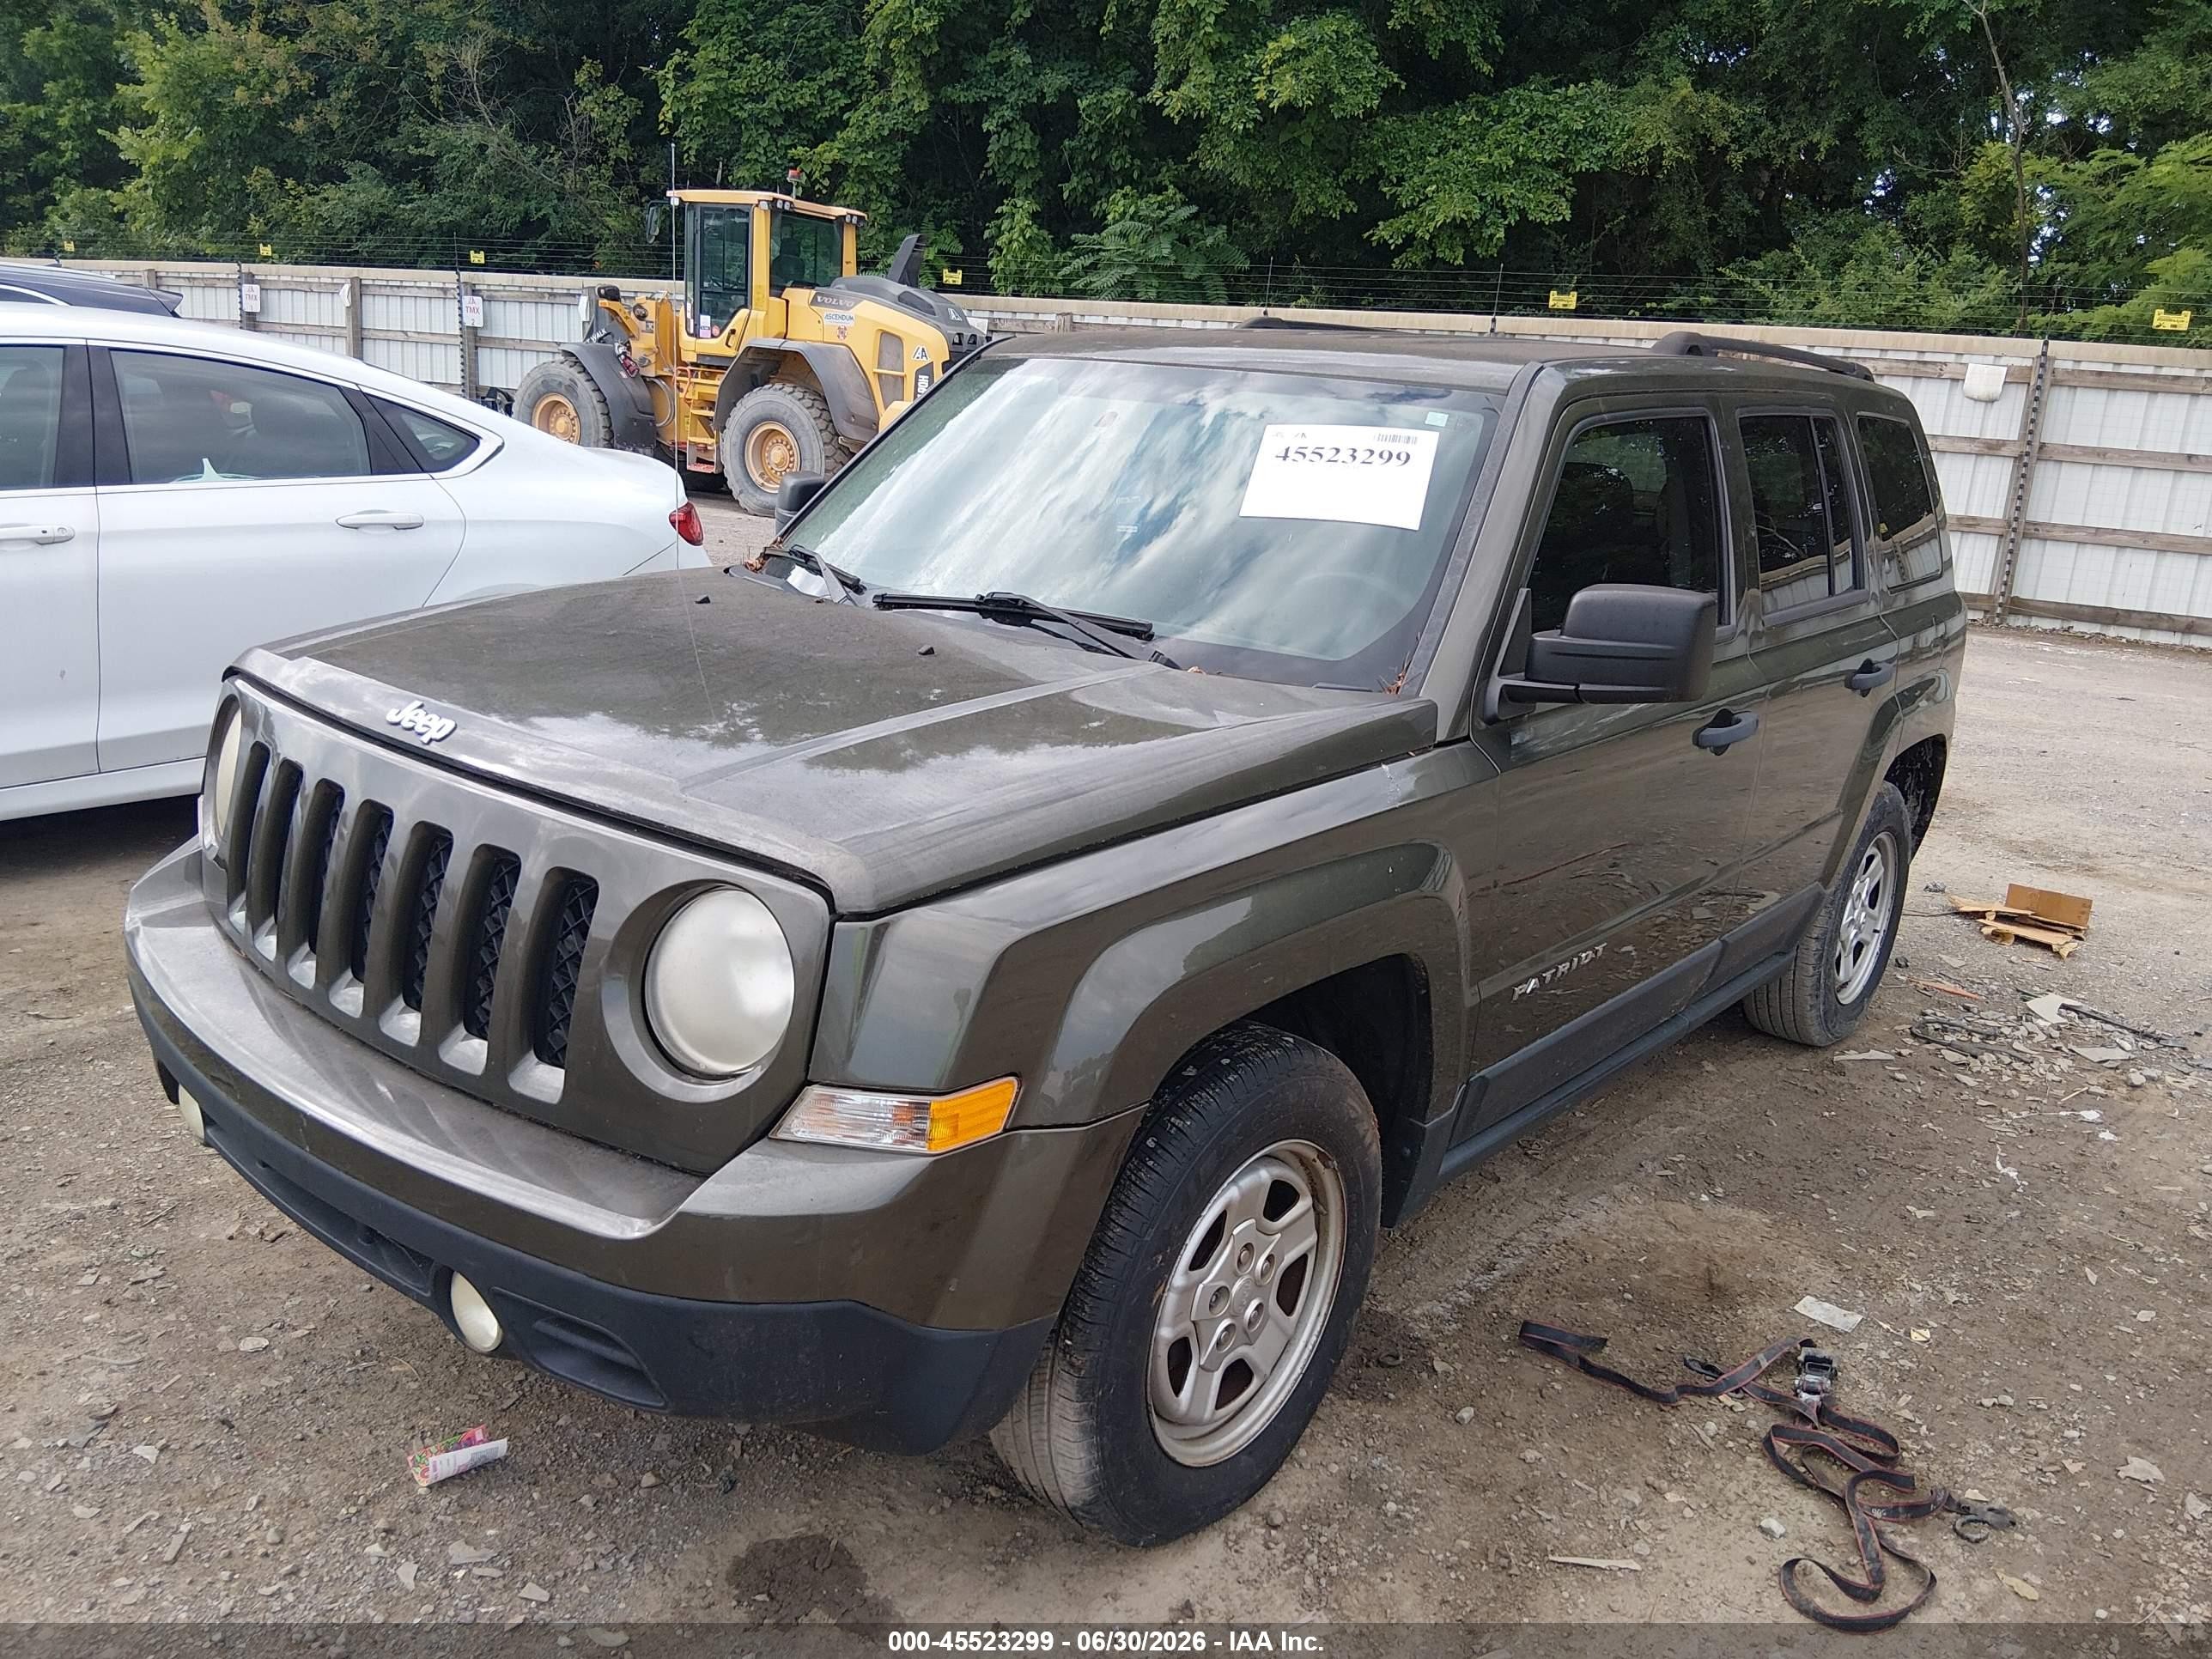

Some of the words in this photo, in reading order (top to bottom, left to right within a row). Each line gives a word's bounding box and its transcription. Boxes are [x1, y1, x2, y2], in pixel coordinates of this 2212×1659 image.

[465, 306, 480, 315] TMX
[817, 295, 854, 307] VOLVO
[1275, 445, 1411, 467] 45523299
[386, 700, 457, 744] Jeep
[1511, 942, 1607, 1002] PATRIOT
